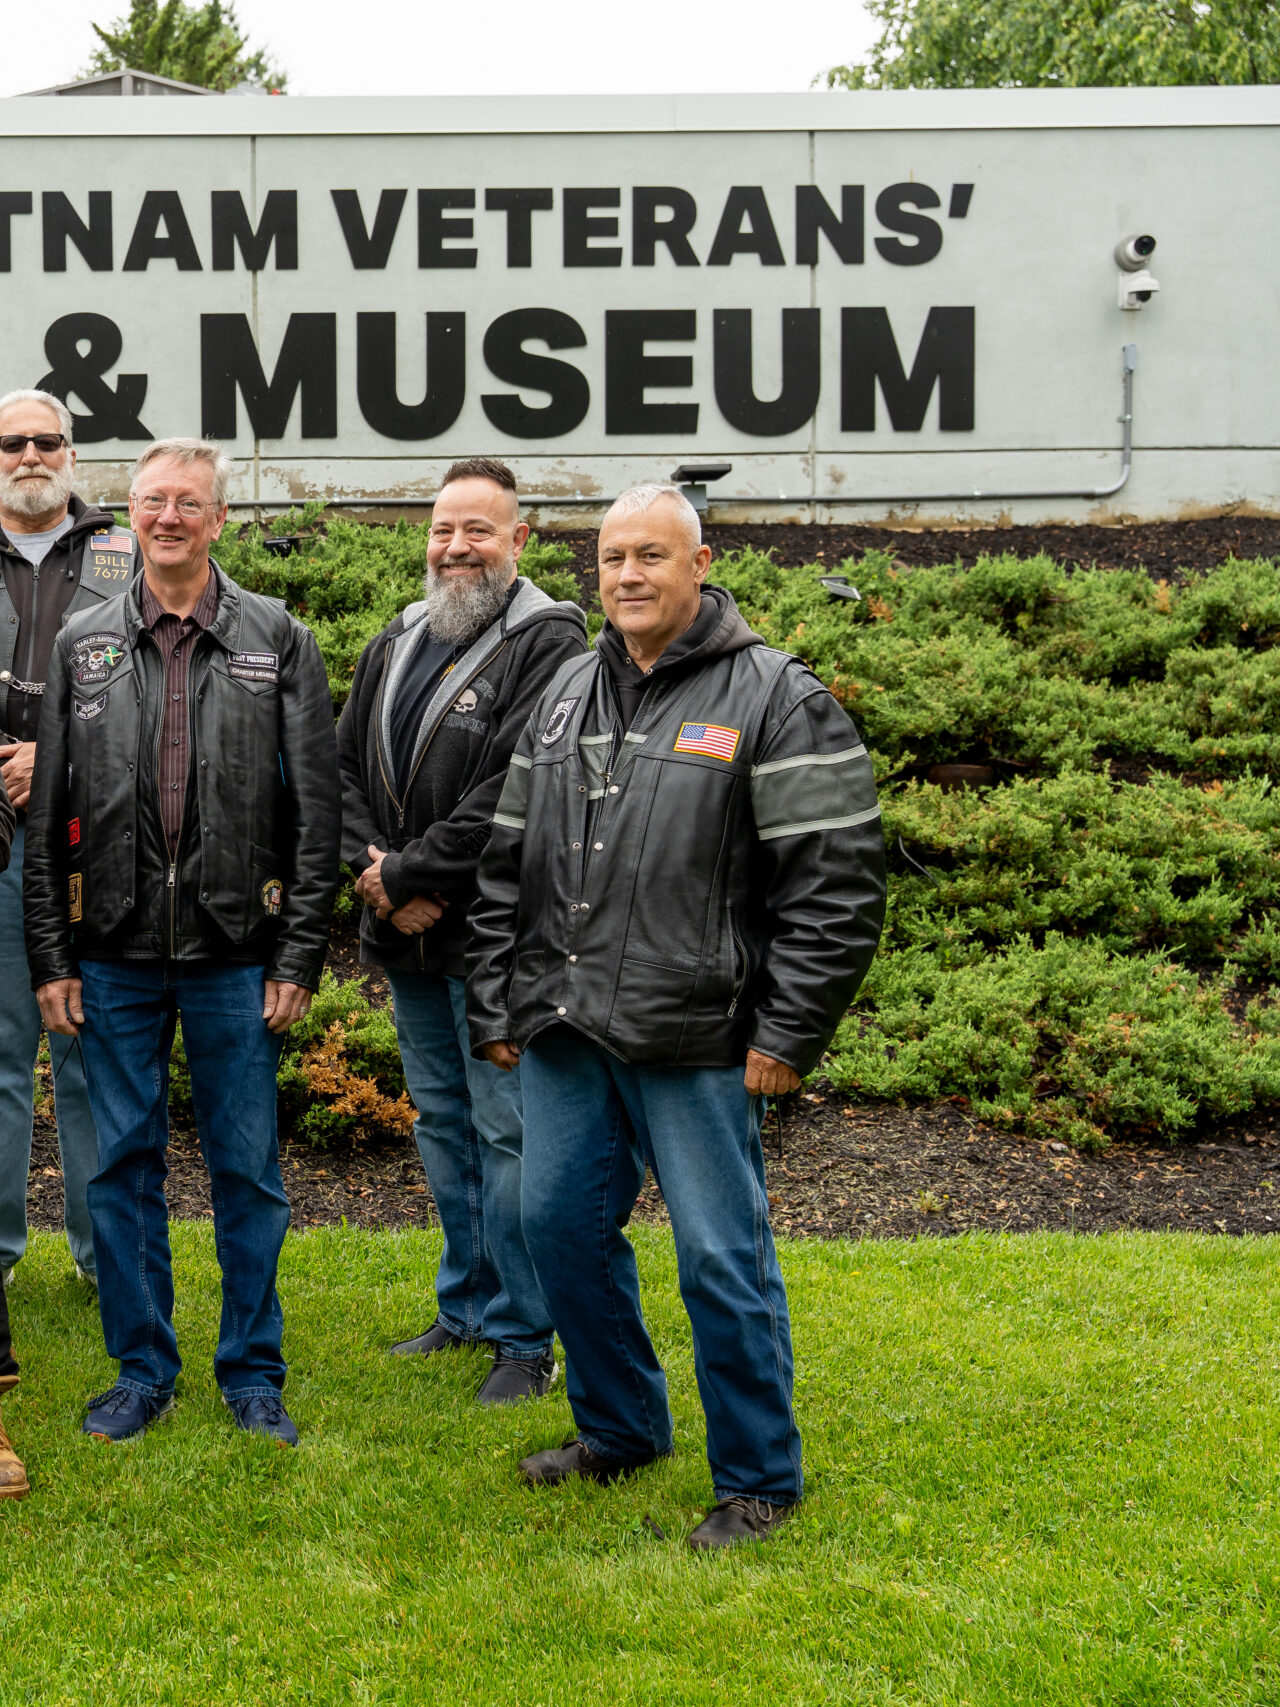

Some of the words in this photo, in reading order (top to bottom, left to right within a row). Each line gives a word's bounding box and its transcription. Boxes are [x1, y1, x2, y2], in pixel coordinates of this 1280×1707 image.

[34, 311, 154, 444] &
[200, 305, 976, 439] MUSEUM
[95, 555, 129, 567] BILL
[93, 567, 128, 580] 7677
[247, 655, 274, 664] PRESIDENT
[82, 672, 106, 680] JAMAICA
